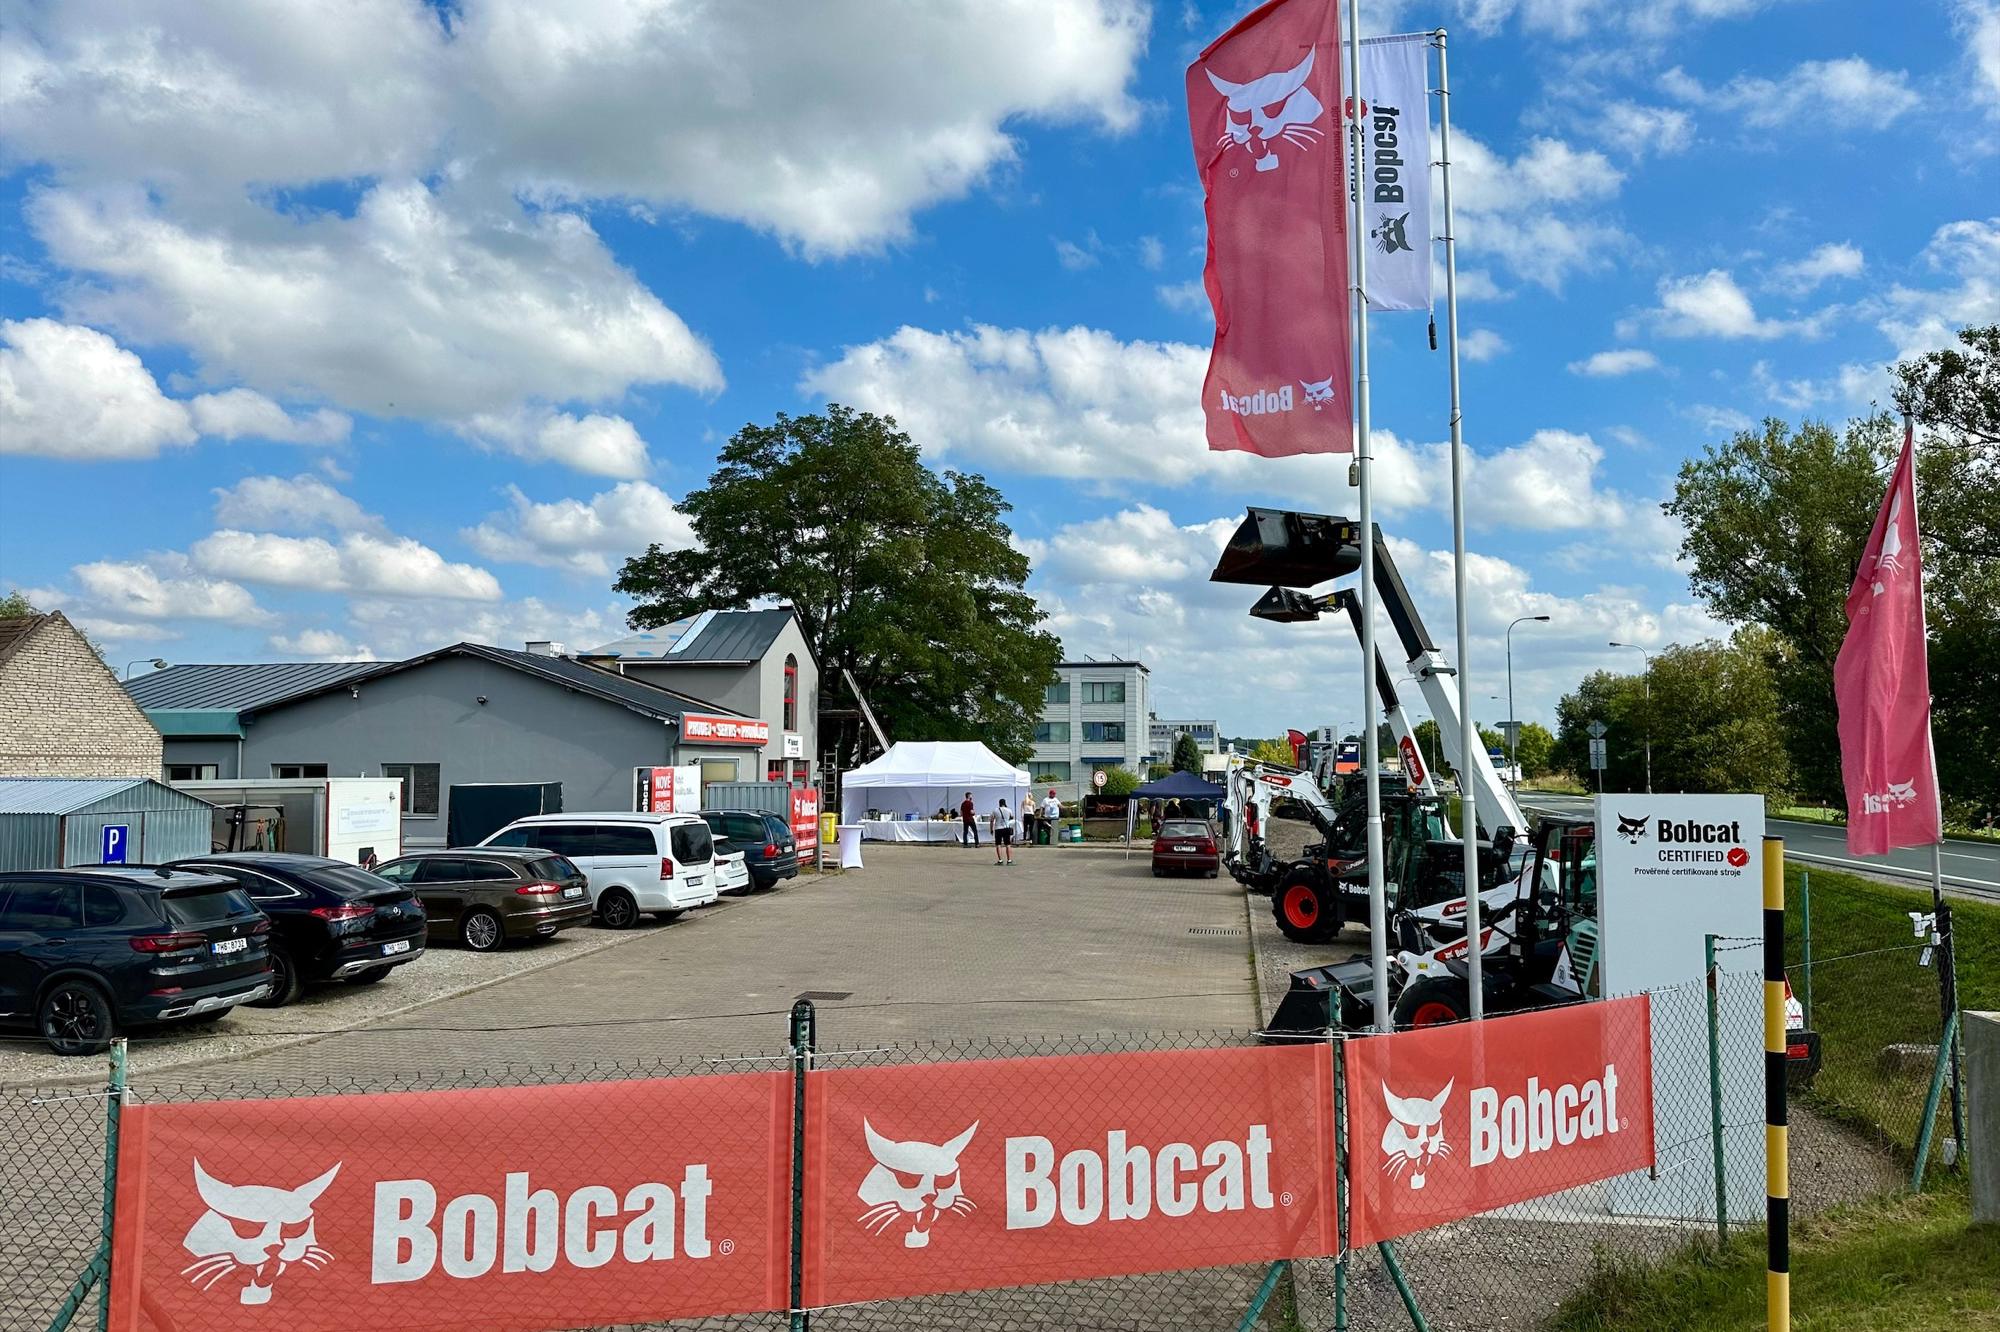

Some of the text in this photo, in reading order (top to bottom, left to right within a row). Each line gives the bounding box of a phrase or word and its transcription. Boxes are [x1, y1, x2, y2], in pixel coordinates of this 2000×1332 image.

[109, 829, 120, 855] P
[1658, 819, 1740, 843] Bobcat
[1658, 850, 1724, 862] CERTIFIED
[1634, 866, 1741, 877] Prověřené certifikované stroje
[1470, 1064, 1619, 1168] Bobcat
[1005, 1124, 1275, 1230] Bobcat
[371, 1163, 713, 1285] Bobcat
